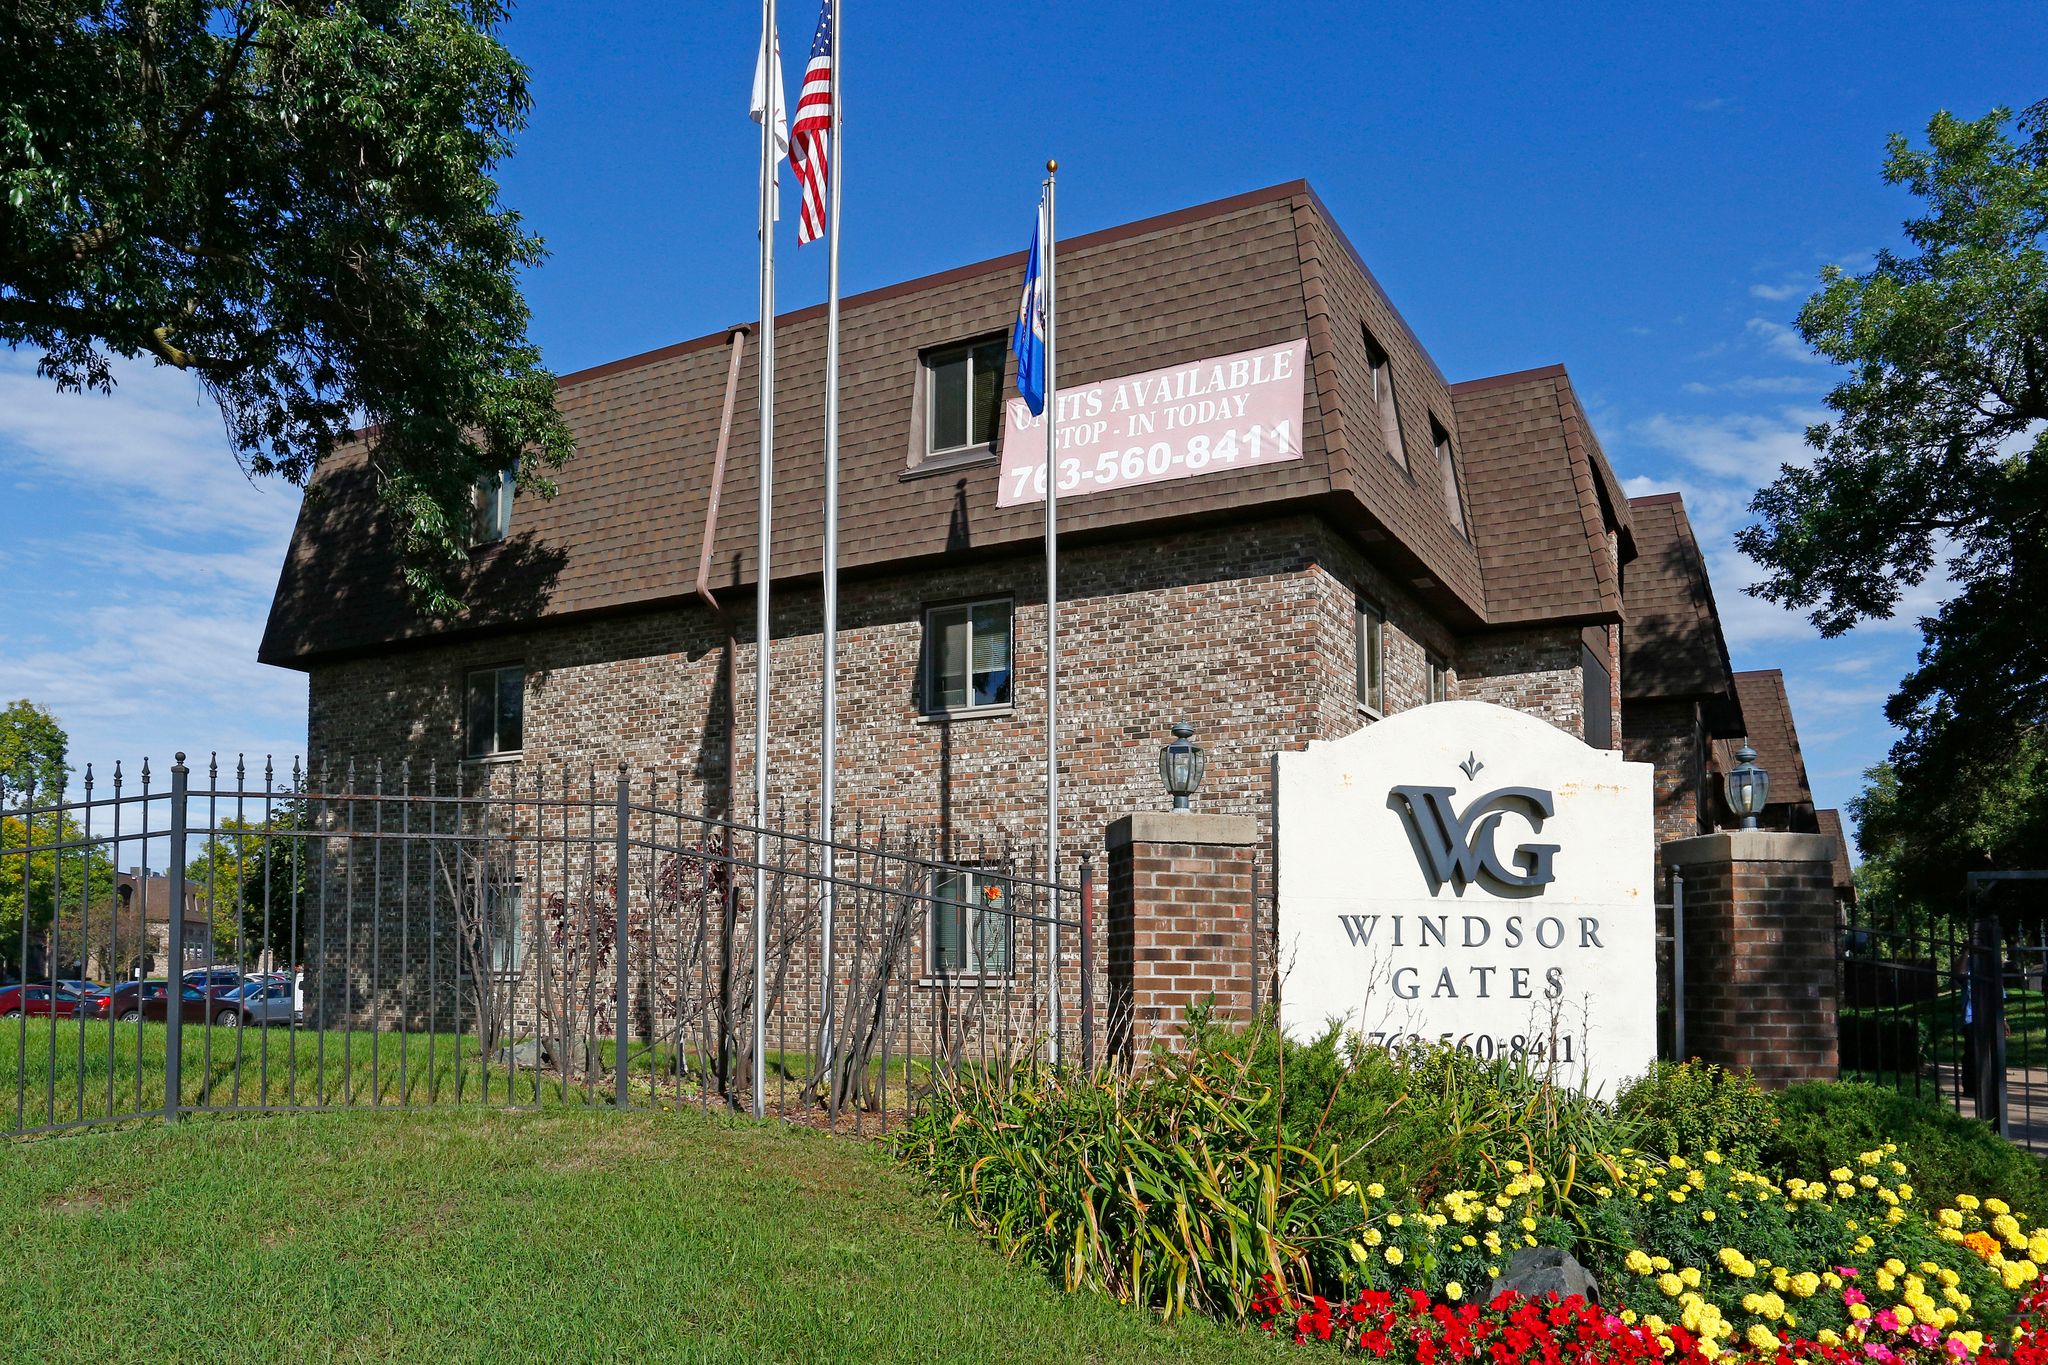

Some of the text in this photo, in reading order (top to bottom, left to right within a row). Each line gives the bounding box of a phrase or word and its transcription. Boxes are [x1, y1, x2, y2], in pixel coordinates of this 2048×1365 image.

[1110, 350, 1293, 413] AVAILABLE
[1127, 413, 1156, 437] IN
[1163, 393, 1250, 430] TODAY
[1011, 420, 1291, 498] 763-560-8411
[1386, 785, 1561, 899] WG
[1338, 914, 1605, 948] WINDSOR
[1391, 966, 1563, 1000] GATES
